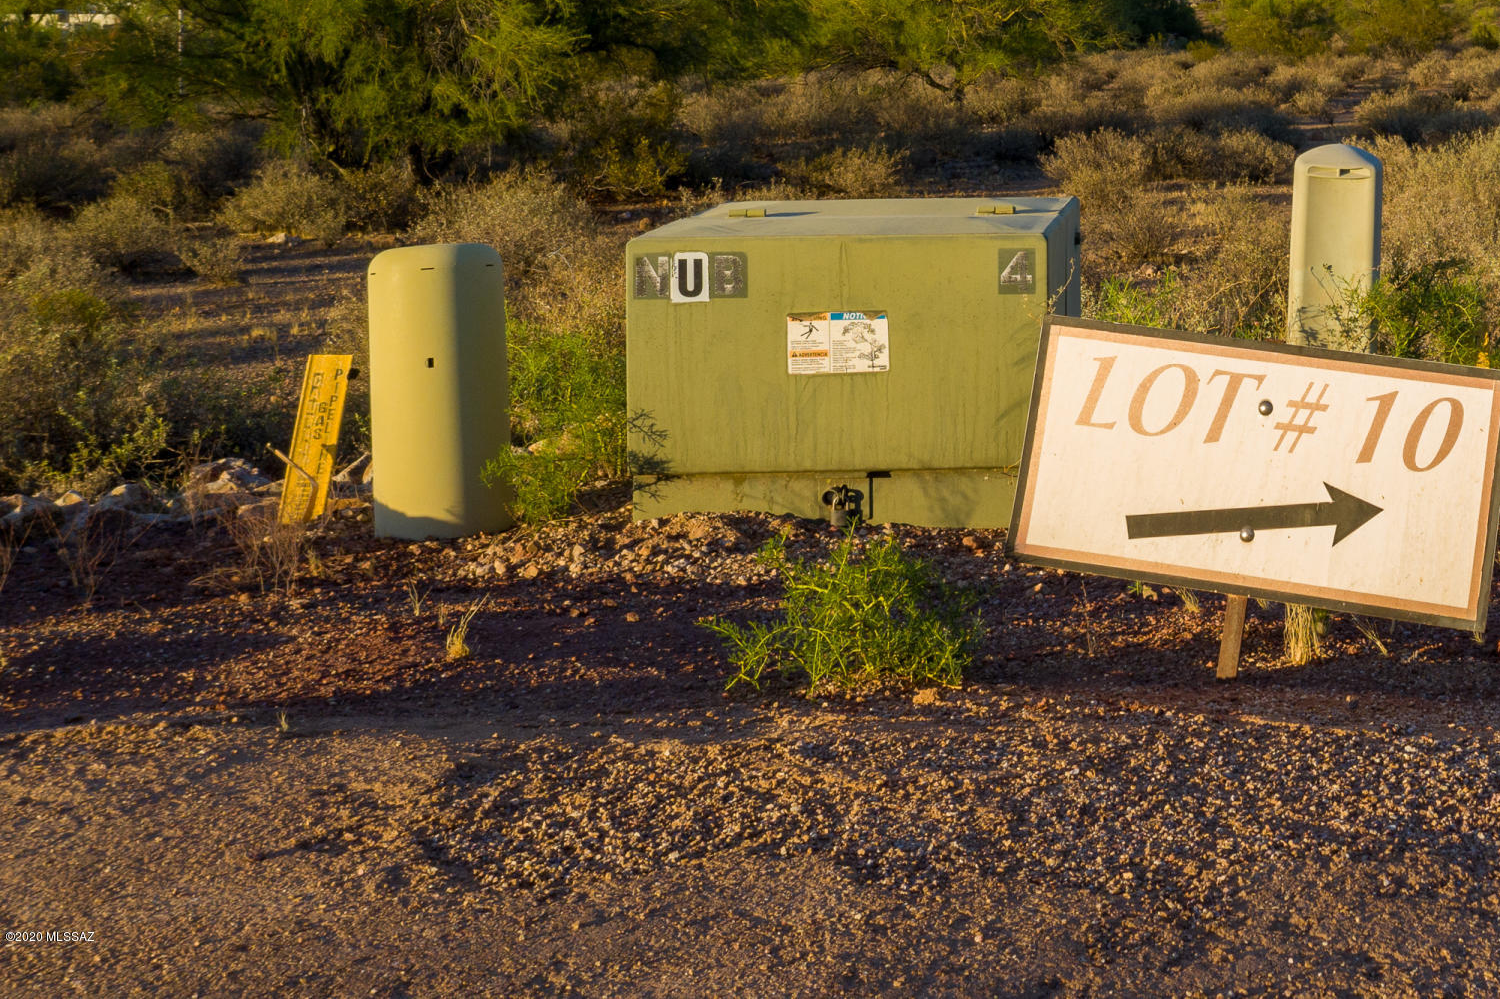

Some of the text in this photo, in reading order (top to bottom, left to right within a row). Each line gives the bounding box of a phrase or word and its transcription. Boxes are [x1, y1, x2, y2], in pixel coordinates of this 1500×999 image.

[636, 256, 743, 298] NUB
[1000, 251, 1032, 291] 4
[843, 312, 866, 320] NOTI
[1075, 355, 1464, 472] LOT # 10
